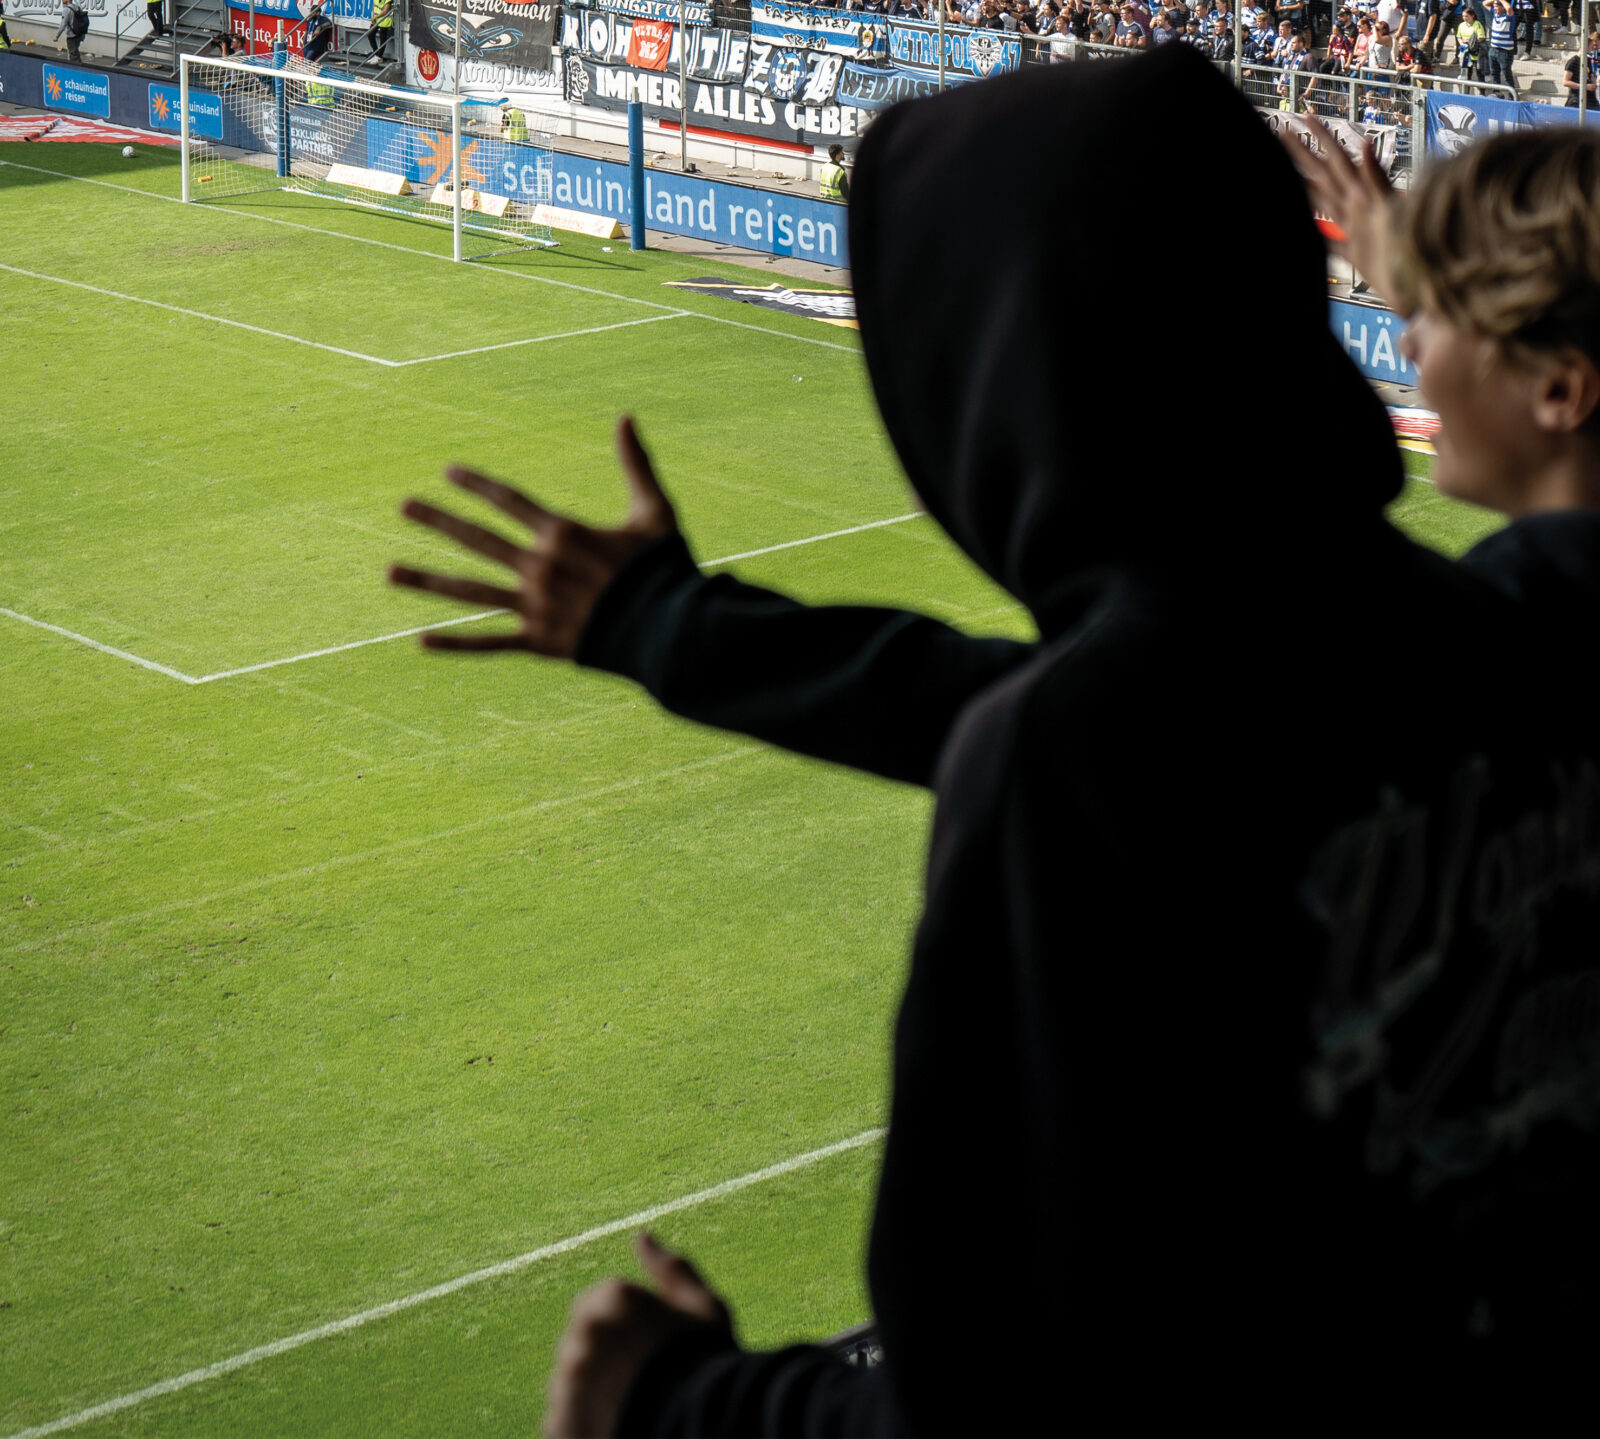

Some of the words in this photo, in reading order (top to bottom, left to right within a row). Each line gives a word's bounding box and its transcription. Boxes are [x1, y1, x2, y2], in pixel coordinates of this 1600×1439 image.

[562, 13, 749, 74] KOHRTE
[888, 27, 972, 70] METROPOL
[1000, 40, 1022, 74] 47
[64, 79, 108, 97] schauinsland
[65, 92, 86, 104] reisen
[596, 66, 681, 109] IMMER
[693, 83, 776, 126] ALLES
[290, 137, 334, 156] PARTNER
[503, 157, 717, 232] schauinland
[729, 198, 837, 257] reisen
